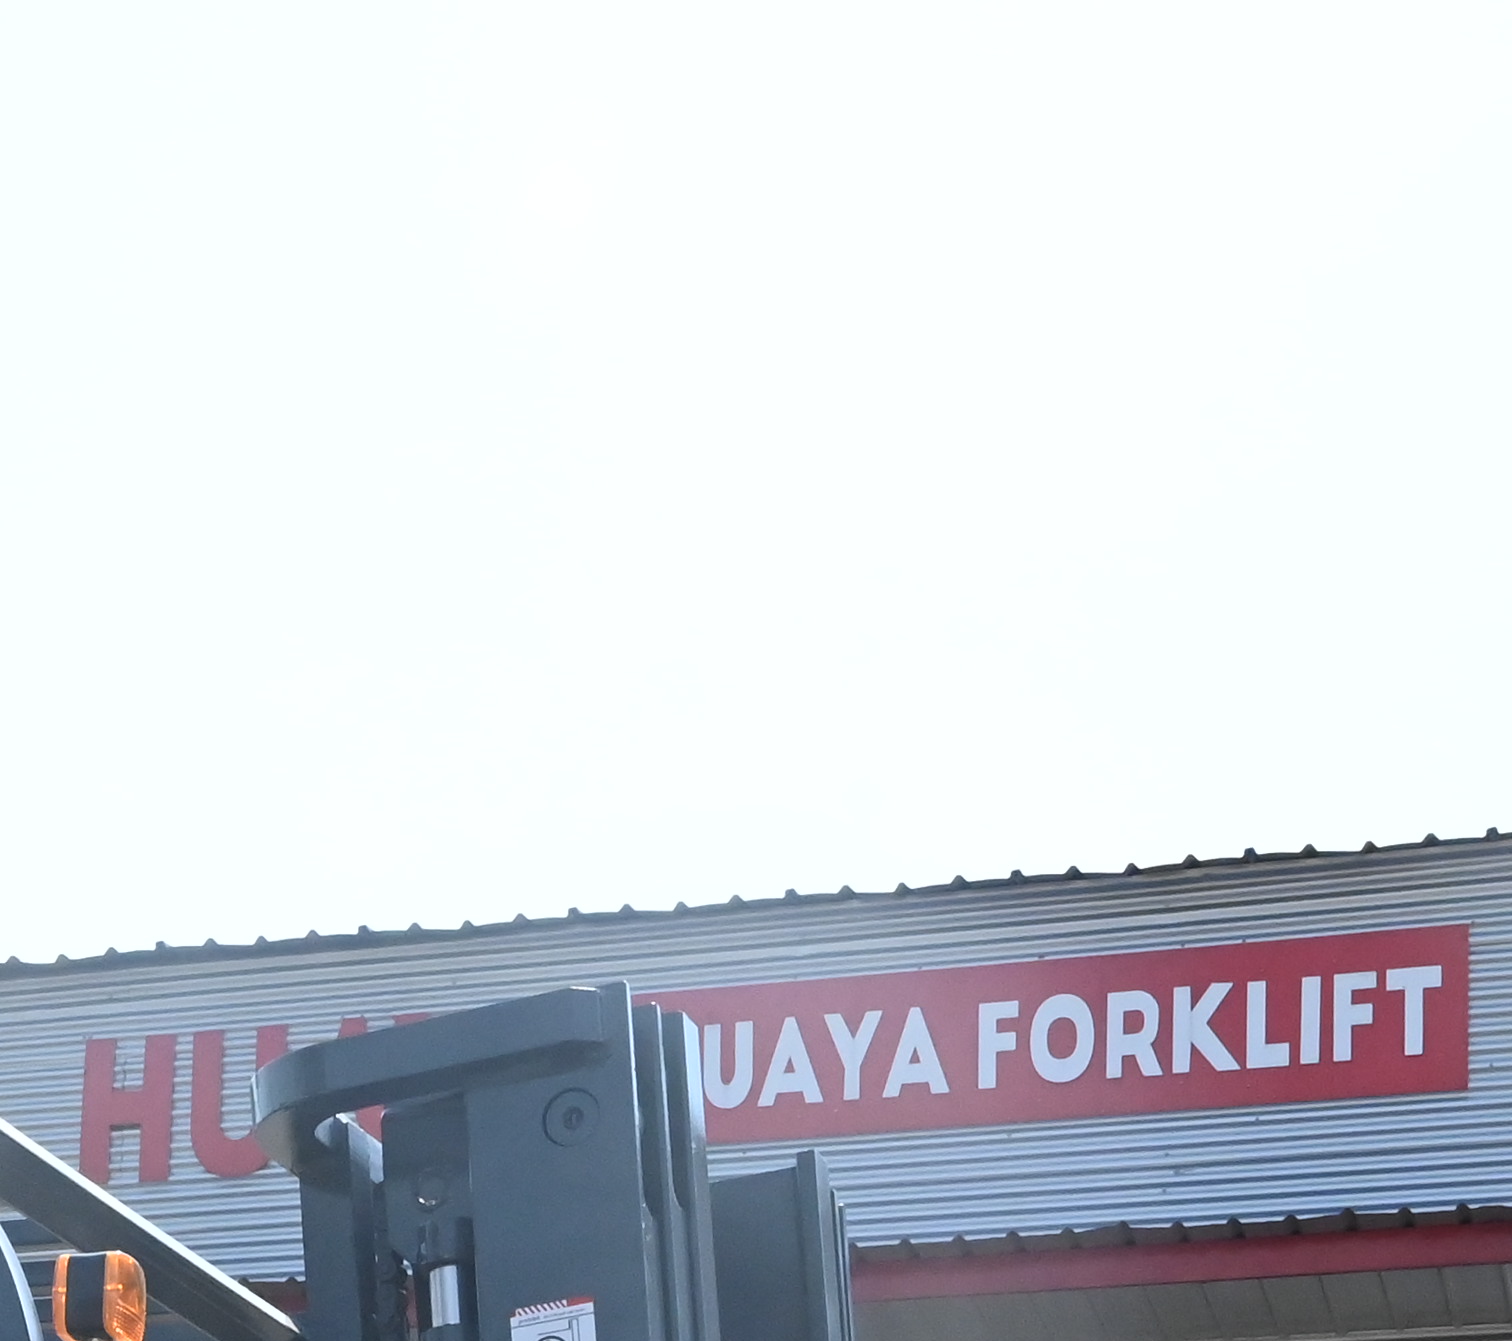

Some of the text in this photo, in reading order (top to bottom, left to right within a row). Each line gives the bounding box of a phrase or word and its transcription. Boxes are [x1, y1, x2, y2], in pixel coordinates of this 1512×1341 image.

[79, 1013, 433, 1185] HU
[701, 964, 1443, 1110] UAYA FORKLIFT
